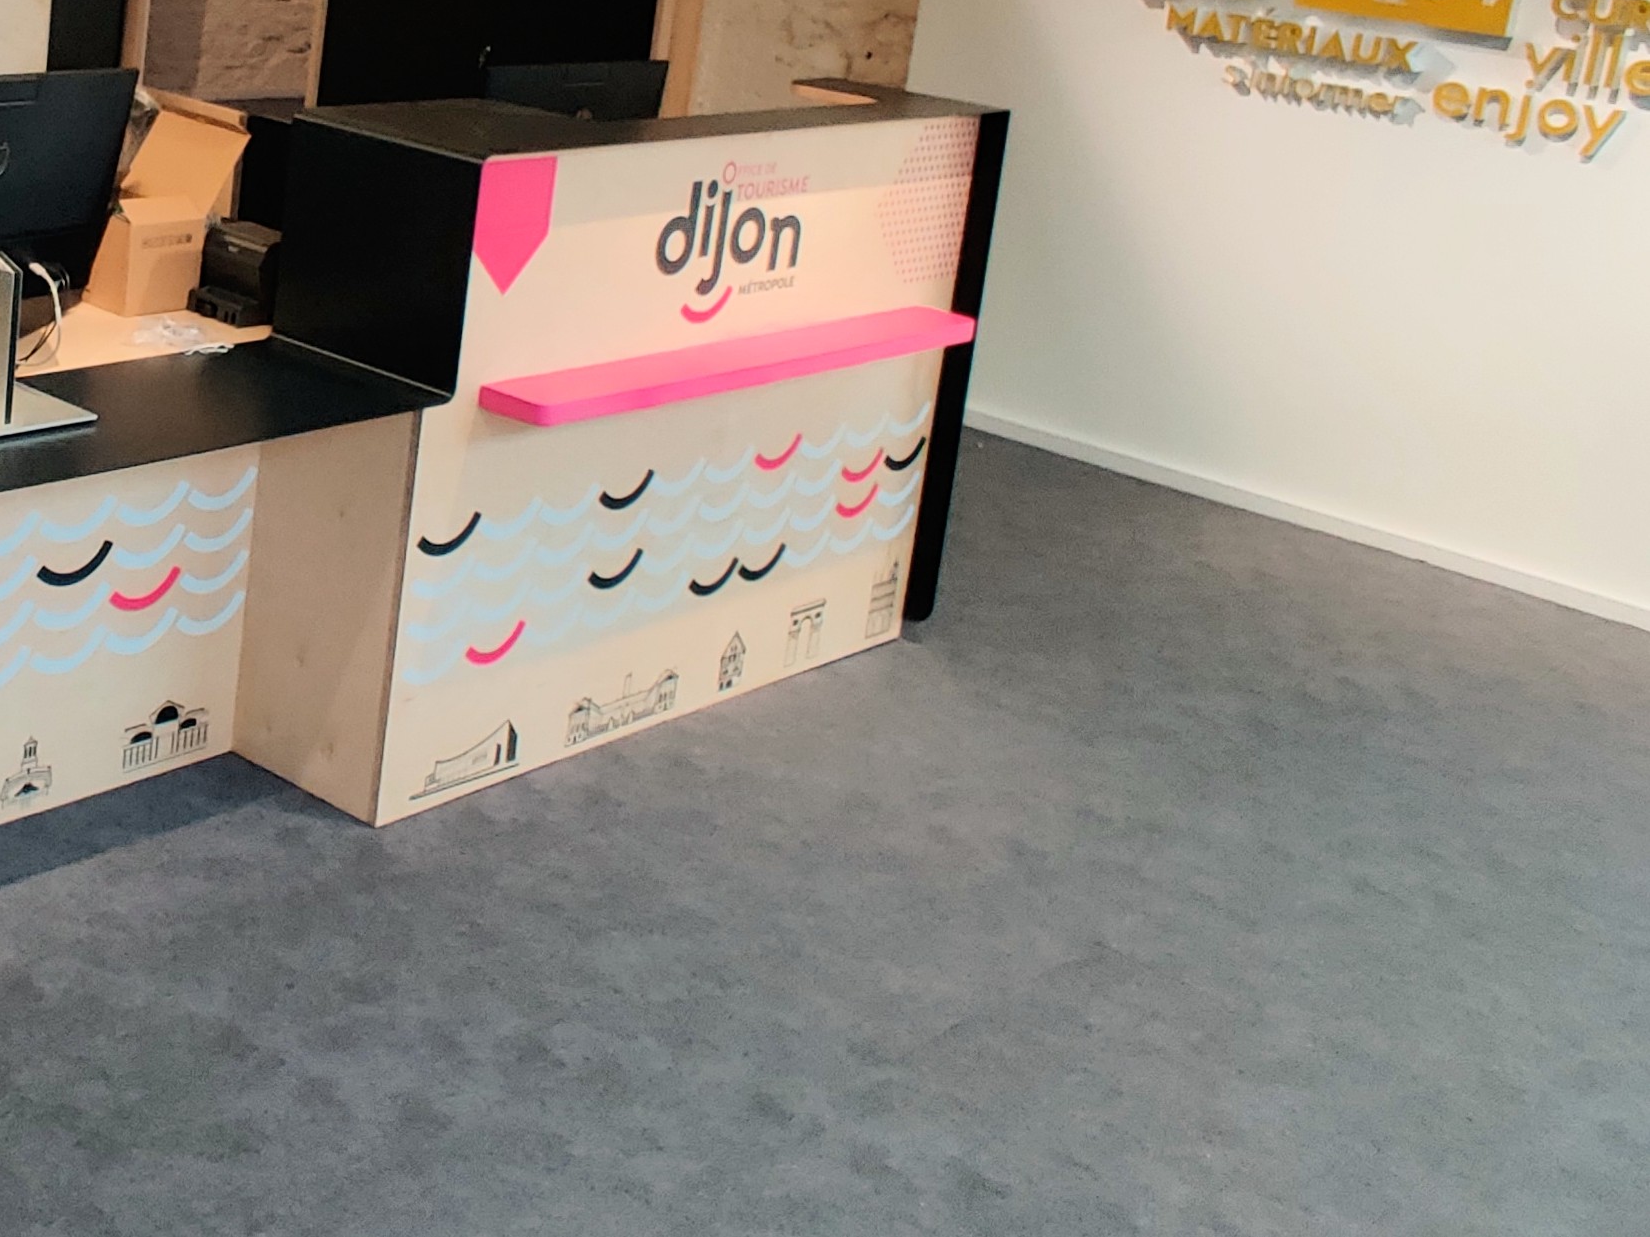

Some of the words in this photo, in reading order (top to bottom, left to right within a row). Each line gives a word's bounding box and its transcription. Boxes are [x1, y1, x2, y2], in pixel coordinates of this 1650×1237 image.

[1165, 0, 1417, 72] MATÉRIAUX
[1432, 80, 1627, 158] enjoy
[736, 175, 810, 202] TOURISME
[656, 180, 802, 296] dijon
